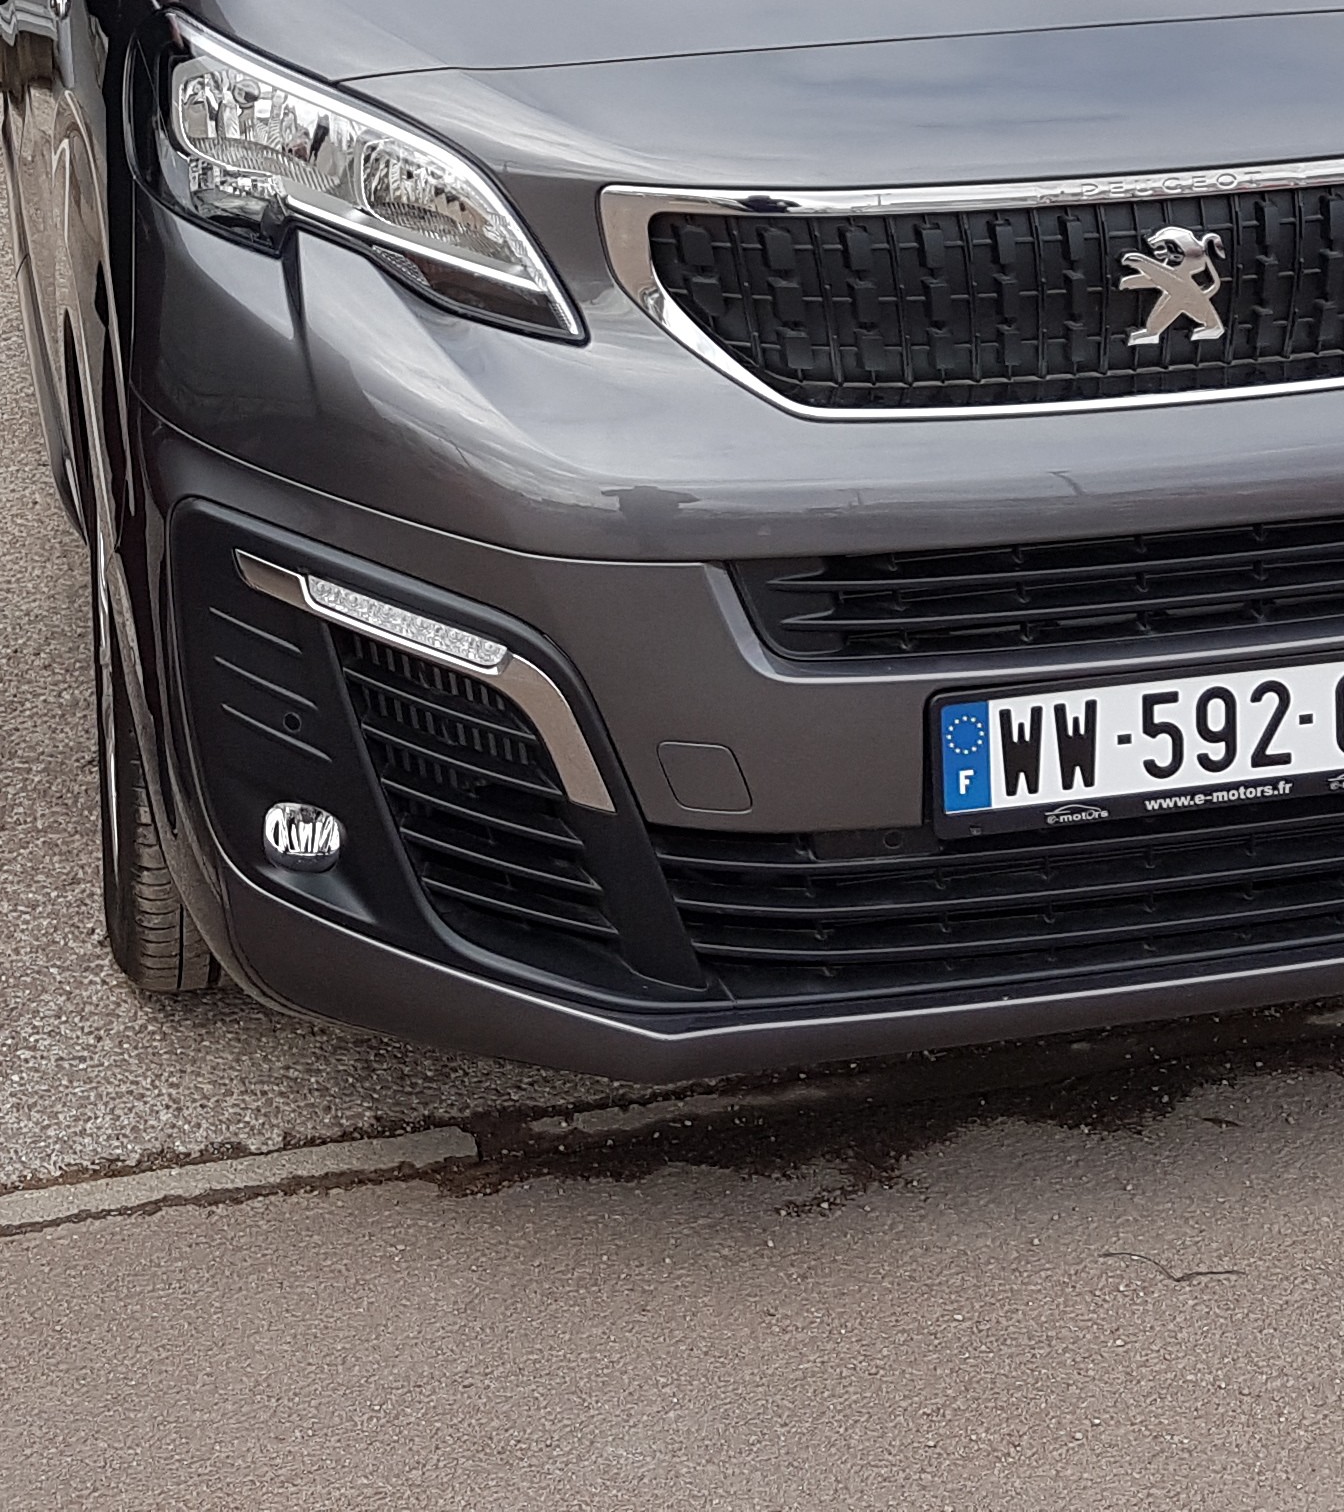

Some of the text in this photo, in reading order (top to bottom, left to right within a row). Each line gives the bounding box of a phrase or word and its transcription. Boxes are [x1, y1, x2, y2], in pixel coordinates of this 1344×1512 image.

[1080, 171, 1262, 200] PEUGEOT
[959, 770, 974, 795] F
[1144, 780, 1293, 811] www.e-motors.fr
